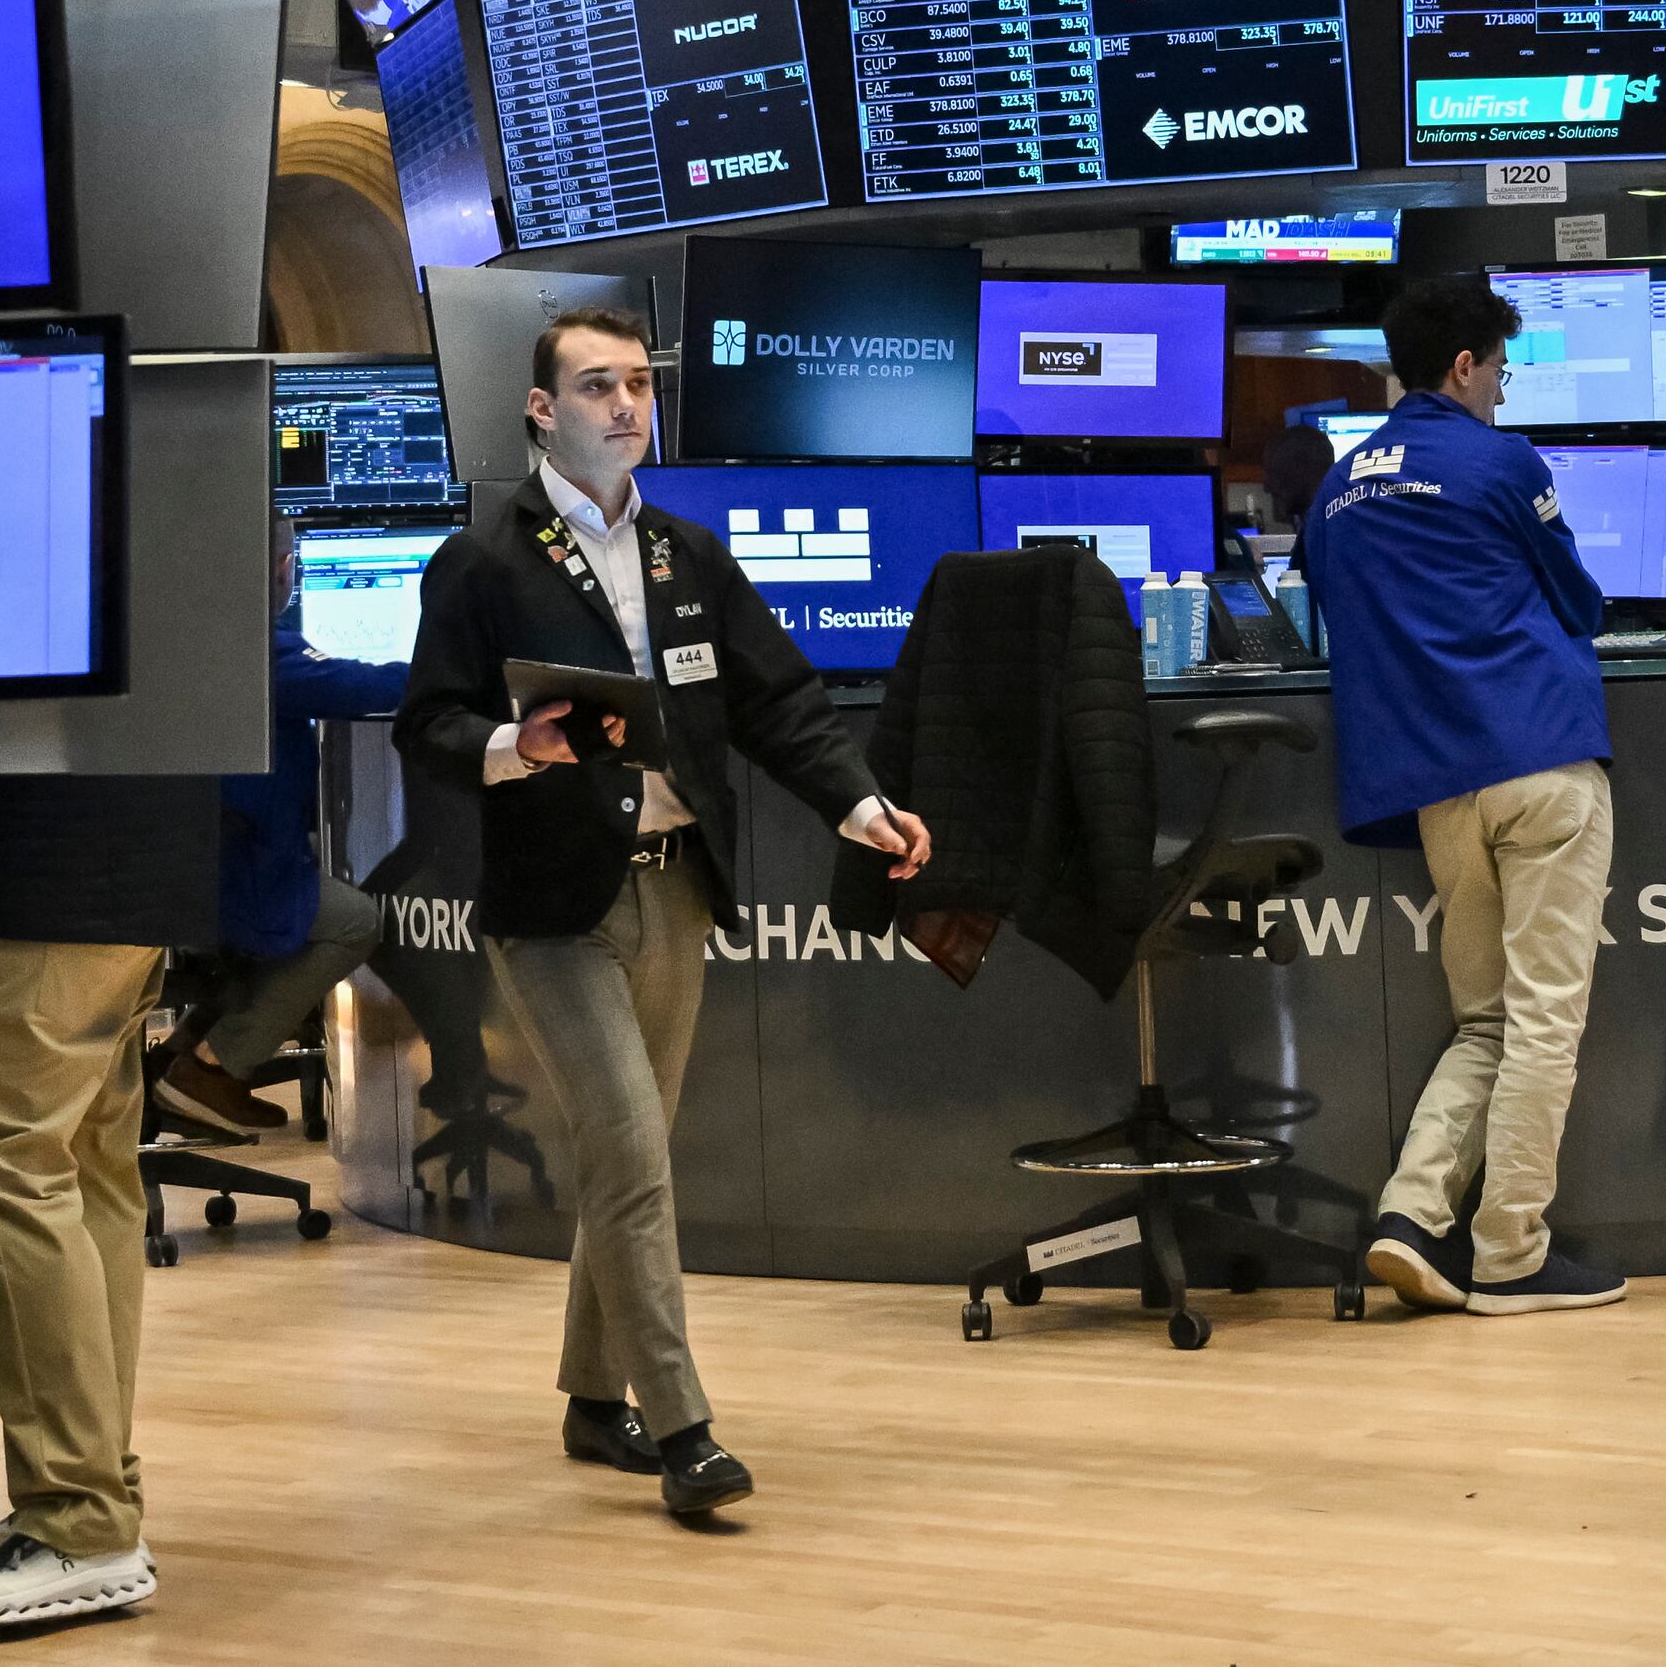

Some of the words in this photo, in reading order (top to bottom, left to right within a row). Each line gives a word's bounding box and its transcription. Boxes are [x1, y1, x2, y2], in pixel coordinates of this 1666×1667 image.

[859, 10, 886, 24] BCO
[927, 2, 967, 15] 87.5400
[1414, 16, 1445, 29] UNF
[1484, 13, 1534, 26] 171.8800
[674, 14, 757, 45] NUCOR
[863, 57, 896, 71] CULP
[937, 50, 971, 63] 3.8100
[652, 89, 670, 103] TEX
[696, 79, 724, 94] 34.5000
[1429, 95, 1529, 120] UniFirst
[1184, 104, 1308, 142] EMCOR
[1416, 129, 1477, 144] Uniforms
[1488, 127, 1546, 142] Services
[1557, 124, 1619, 140] Solutions
[710, 149, 789, 180] TEREX
[1500, 165, 1550, 185] 1220
[874, 176, 897, 189] FTK
[947, 170, 981, 183] 6.8200
[1226, 220, 1280, 239] MAD
[756, 333, 843, 358] DOLLY
[849, 336, 955, 361] VARDEN
[796, 363, 860, 376] SILVER
[868, 364, 915, 378] CORP
[1325, 484, 1368, 520] CITADEL
[1379, 481, 1442, 498] Securities
[819, 605, 914, 630] Securitie
[676, 649, 703, 666] 444
[392, 896, 476, 954] YORK
